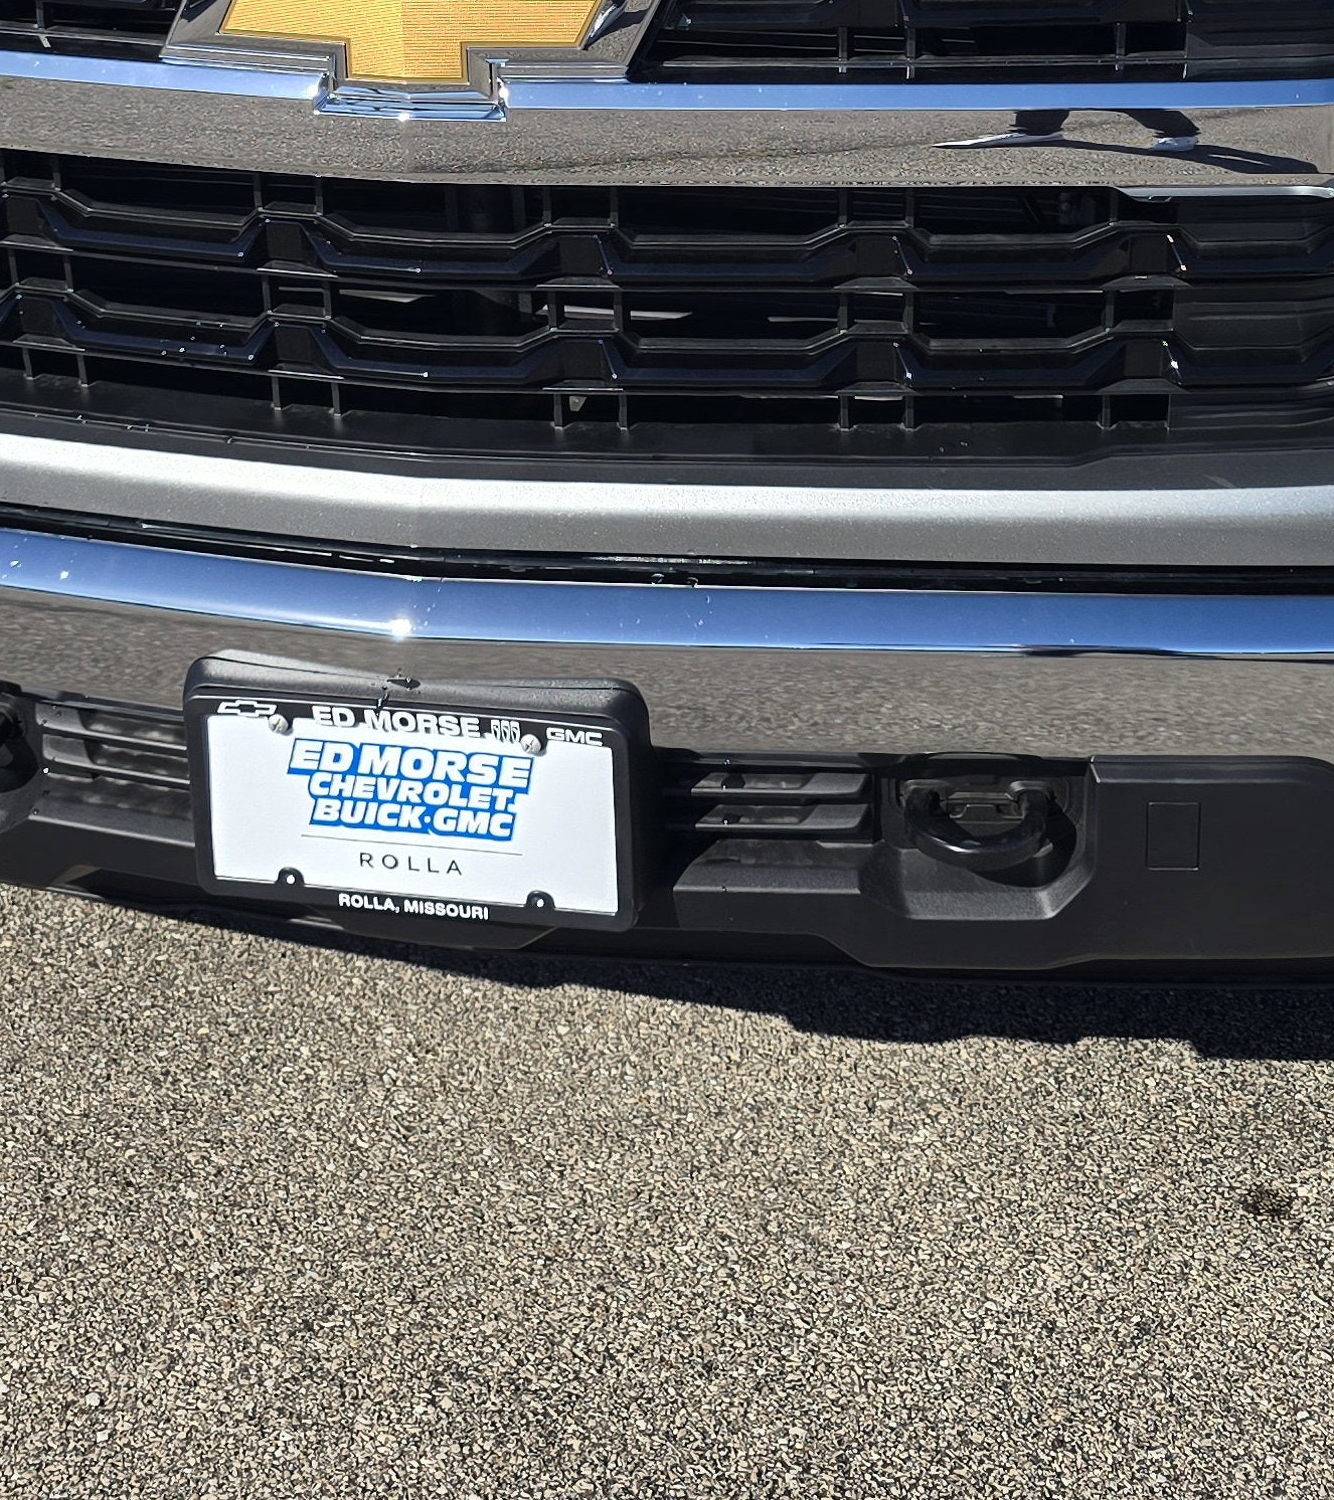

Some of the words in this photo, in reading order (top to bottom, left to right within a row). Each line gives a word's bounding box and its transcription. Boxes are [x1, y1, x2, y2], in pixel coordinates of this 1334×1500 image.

[311, 705, 356, 728] ED
[364, 709, 481, 739] MORSE
[546, 727, 603, 747] GMC
[289, 740, 355, 772] ED
[357, 743, 532, 789] MORSE
[309, 771, 515, 812] CHEVROLET
[359, 852, 463, 876] ROLLA
[338, 893, 400, 913] ROLLA,
[403, 899, 489, 920] MISSOURI
